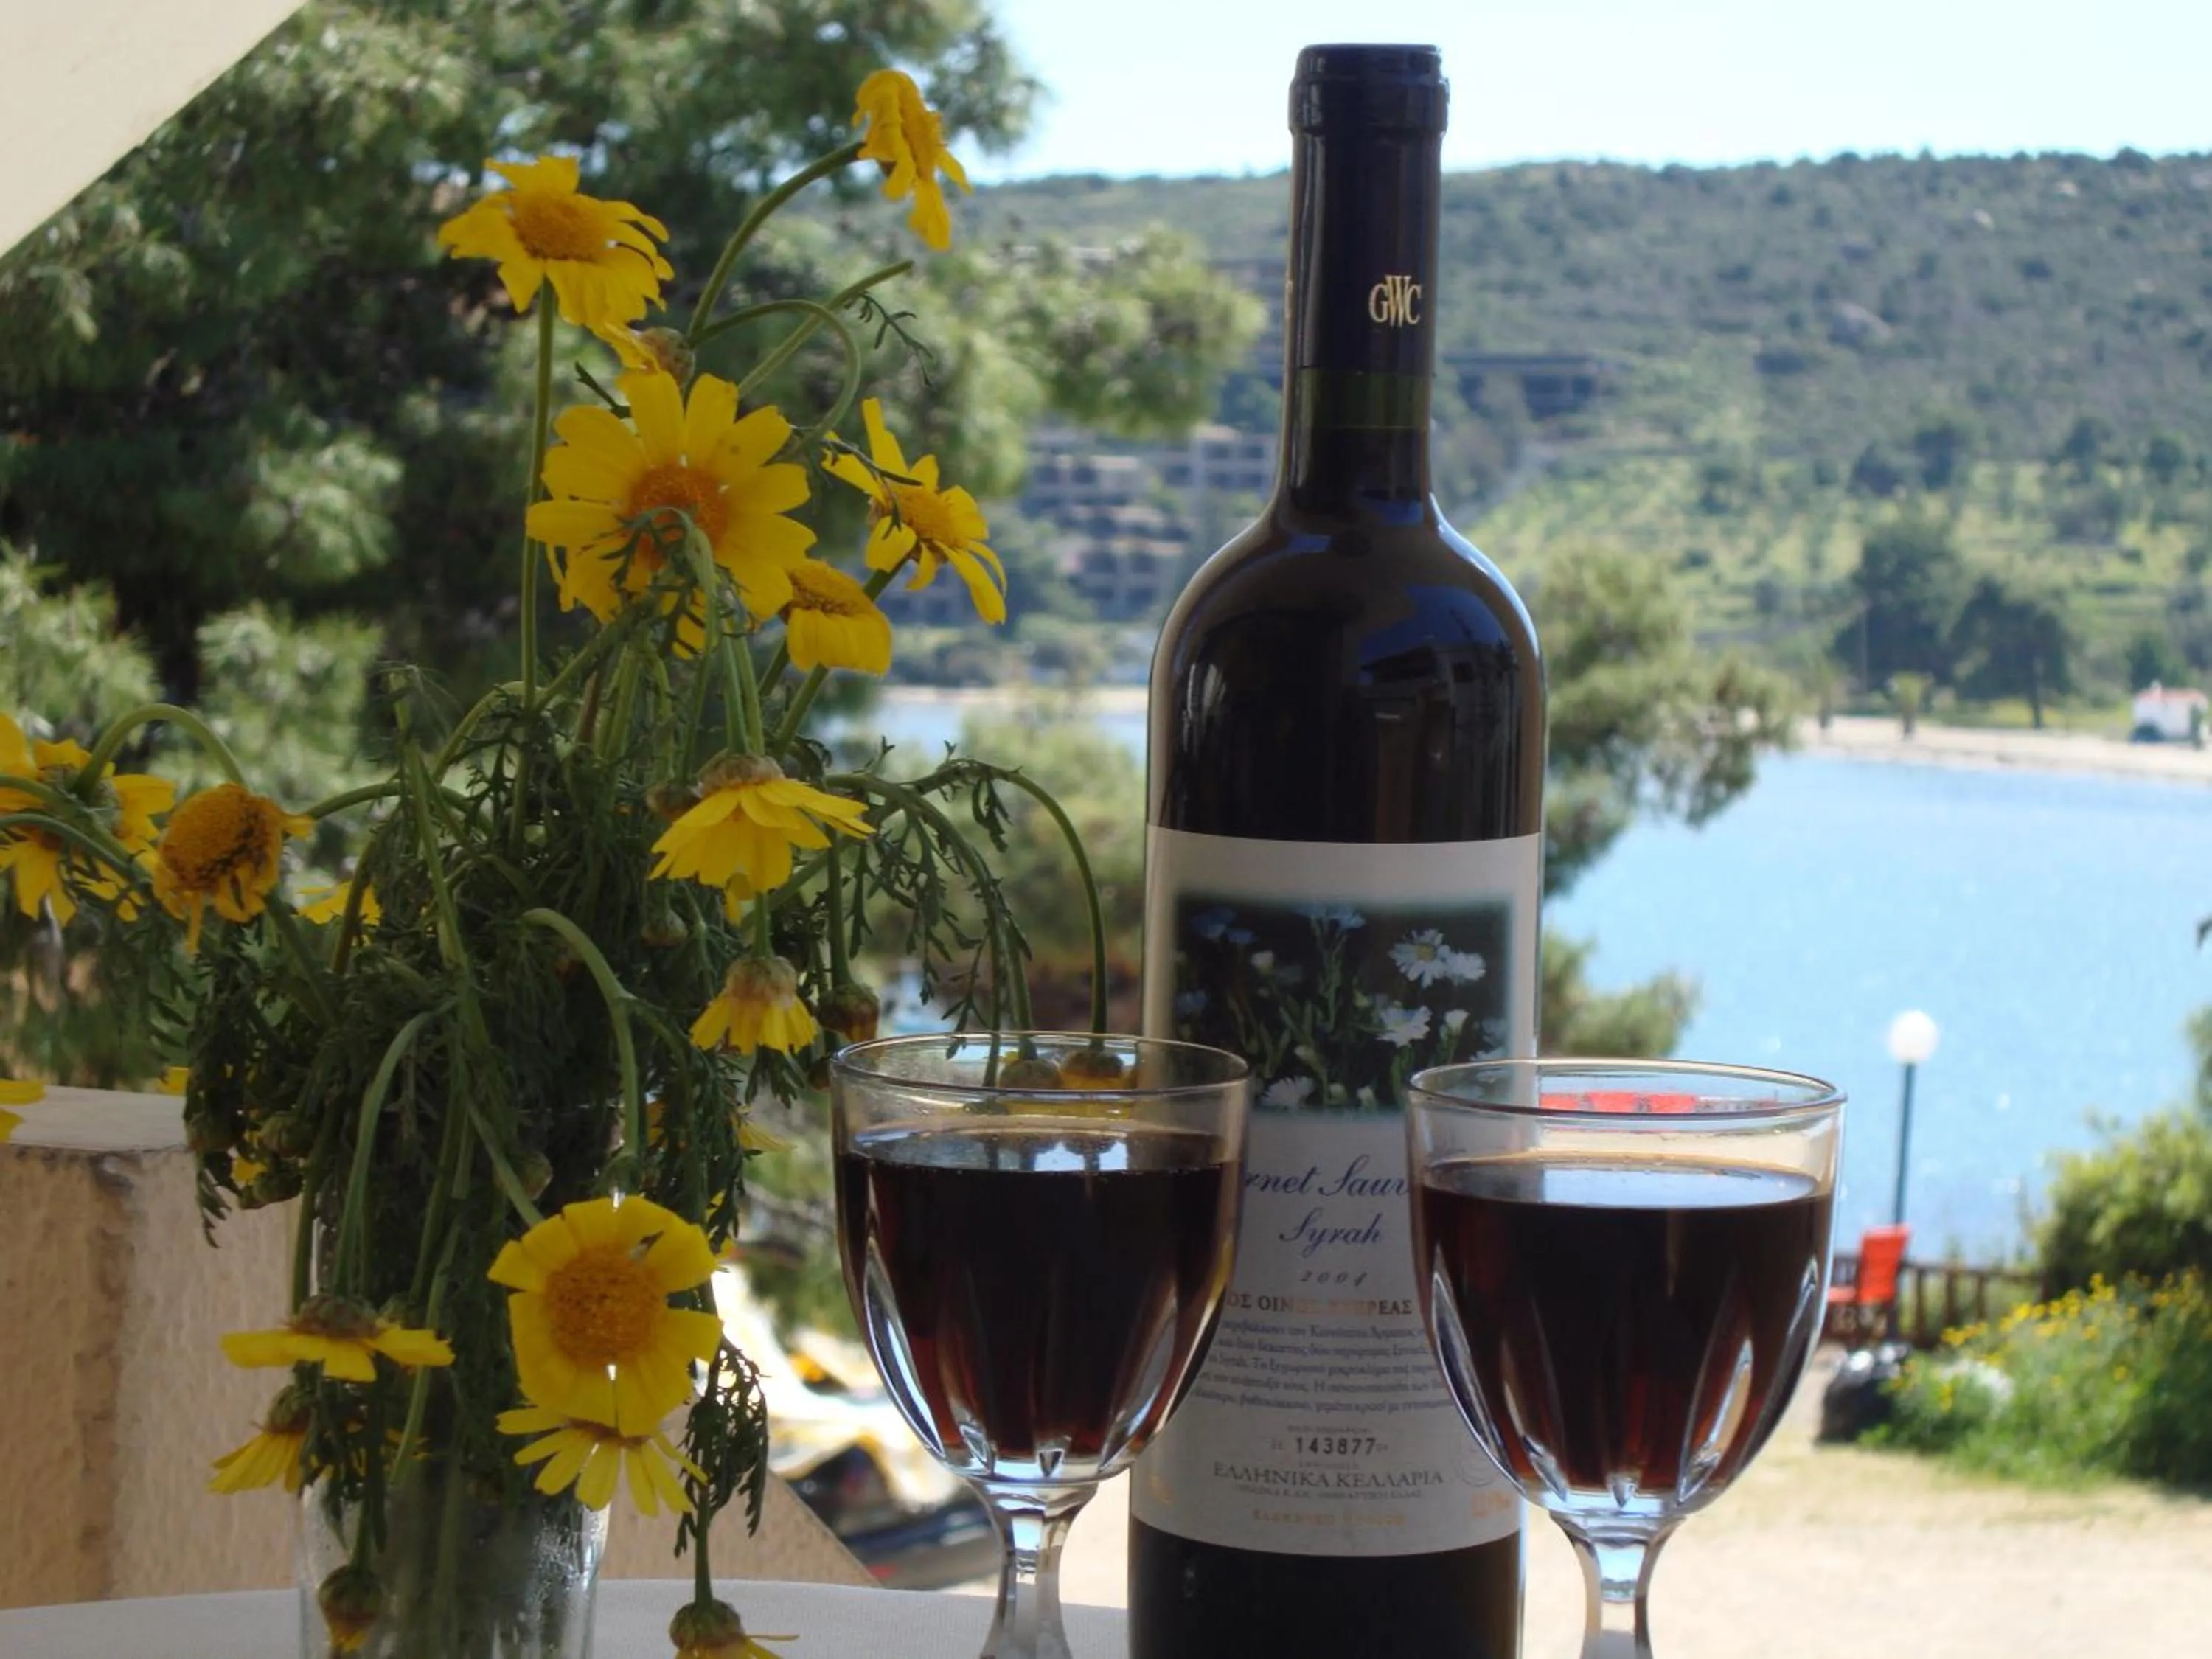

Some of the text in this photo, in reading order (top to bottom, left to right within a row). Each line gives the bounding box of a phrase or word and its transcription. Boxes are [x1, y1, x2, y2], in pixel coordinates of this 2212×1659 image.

[1368, 275, 1422, 327] GWC
[1278, 1207, 1384, 1259] Syrah
[1295, 1436, 1377, 1456] 143877
